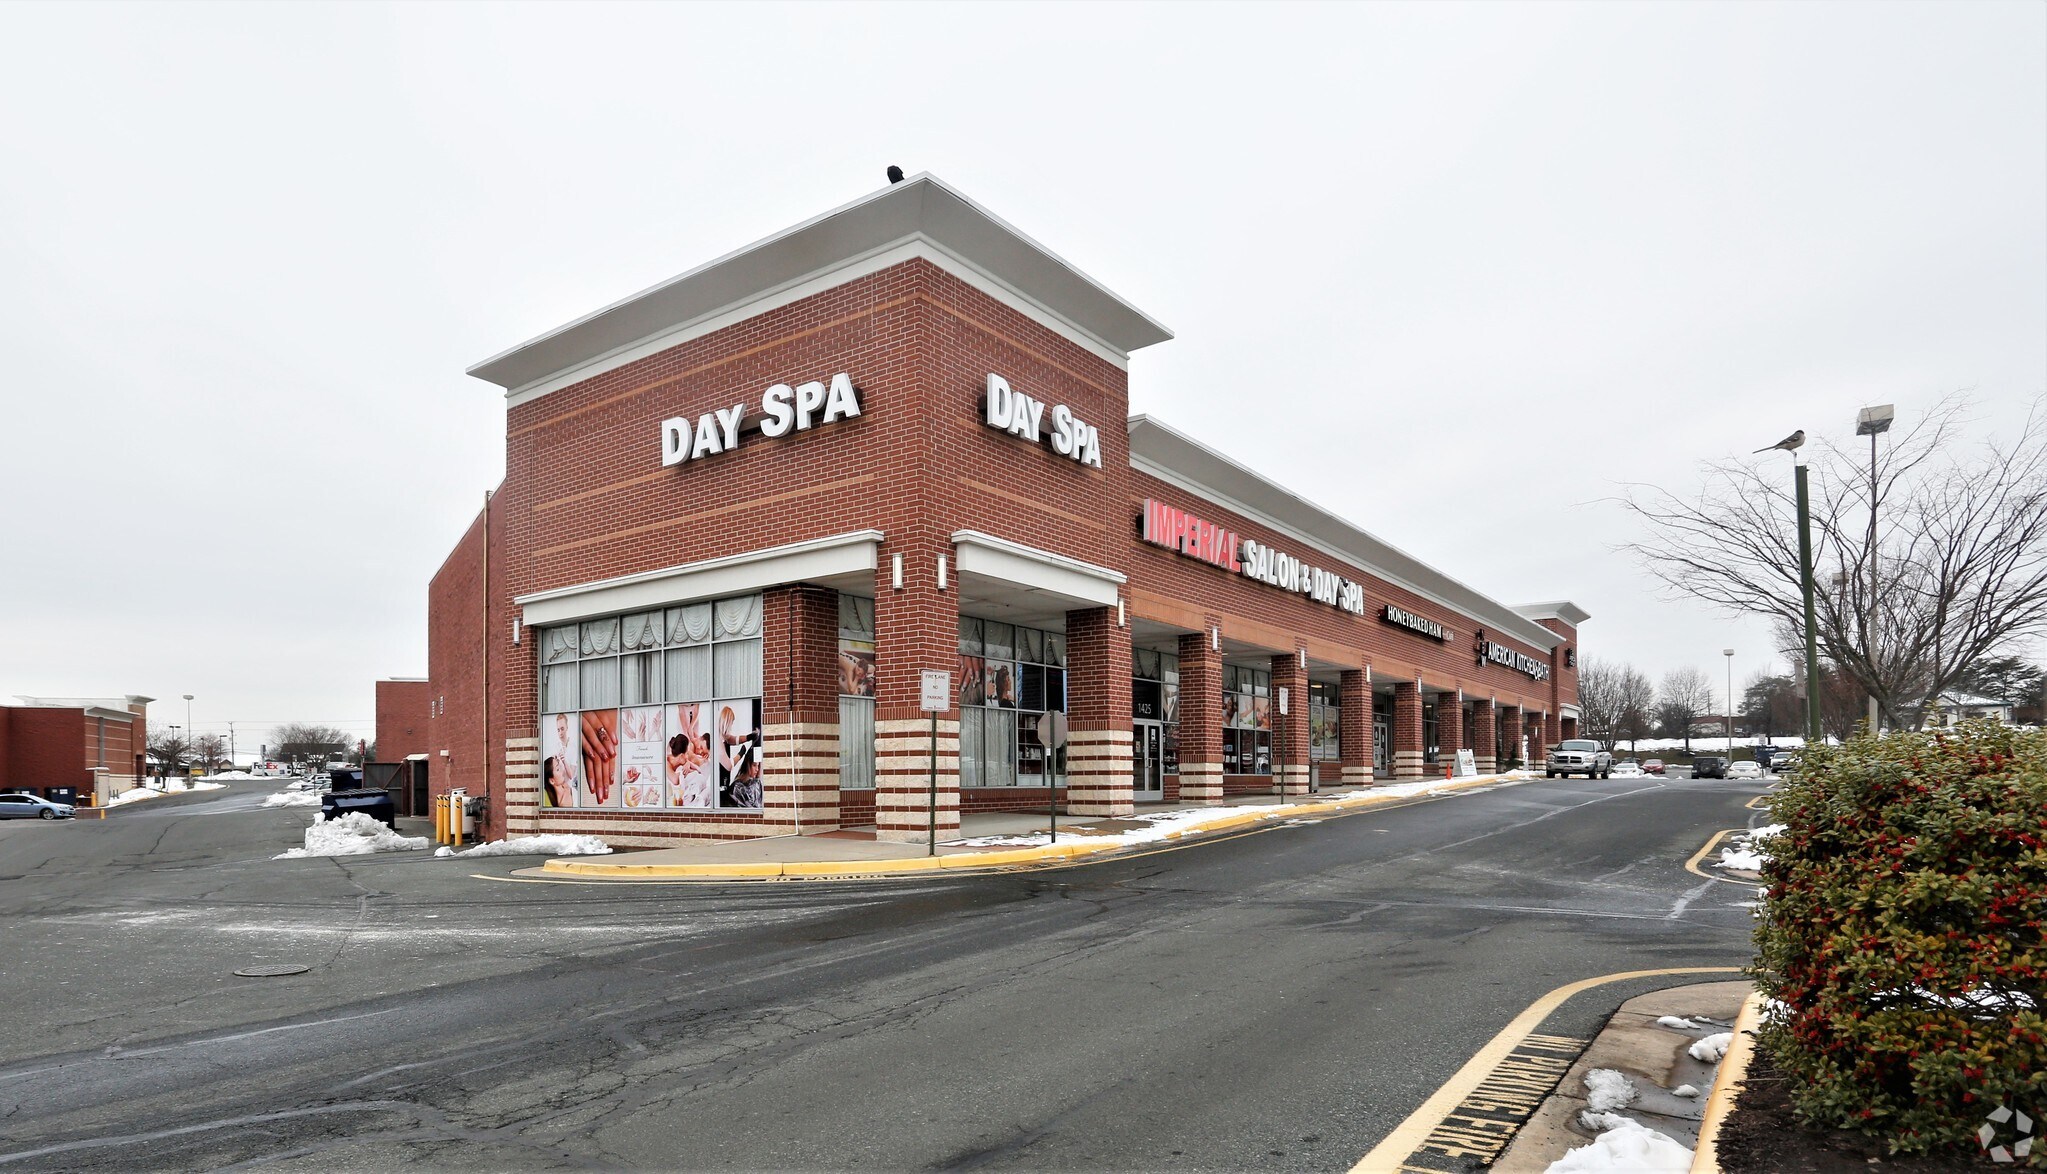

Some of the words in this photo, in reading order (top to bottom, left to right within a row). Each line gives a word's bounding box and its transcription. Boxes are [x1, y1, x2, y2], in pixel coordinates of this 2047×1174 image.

[661, 403, 746, 467] DAY
[760, 372, 861, 438] SPA
[986, 372, 1045, 443] DAY
[1050, 404, 1102, 469] SPA
[1143, 498, 1241, 572] IMPERIAL
[1243, 539, 1300, 593] SALON
[1299, 564, 1312, 593] &
[1311, 566, 1340, 606] DAY
[1339, 578, 1364, 616] SPA
[1387, 604, 1428, 634] HONEYBAKED
[1428, 620, 1442, 639] HAM
[1488, 641, 1516, 668] AMERICAN
[1516, 652, 1536, 676] KITCHEN
[1137, 703, 1152, 714] 1425
[1461, 1053, 1573, 1115] PARKING
[1418, 1114, 1521, 1165] FIRE
